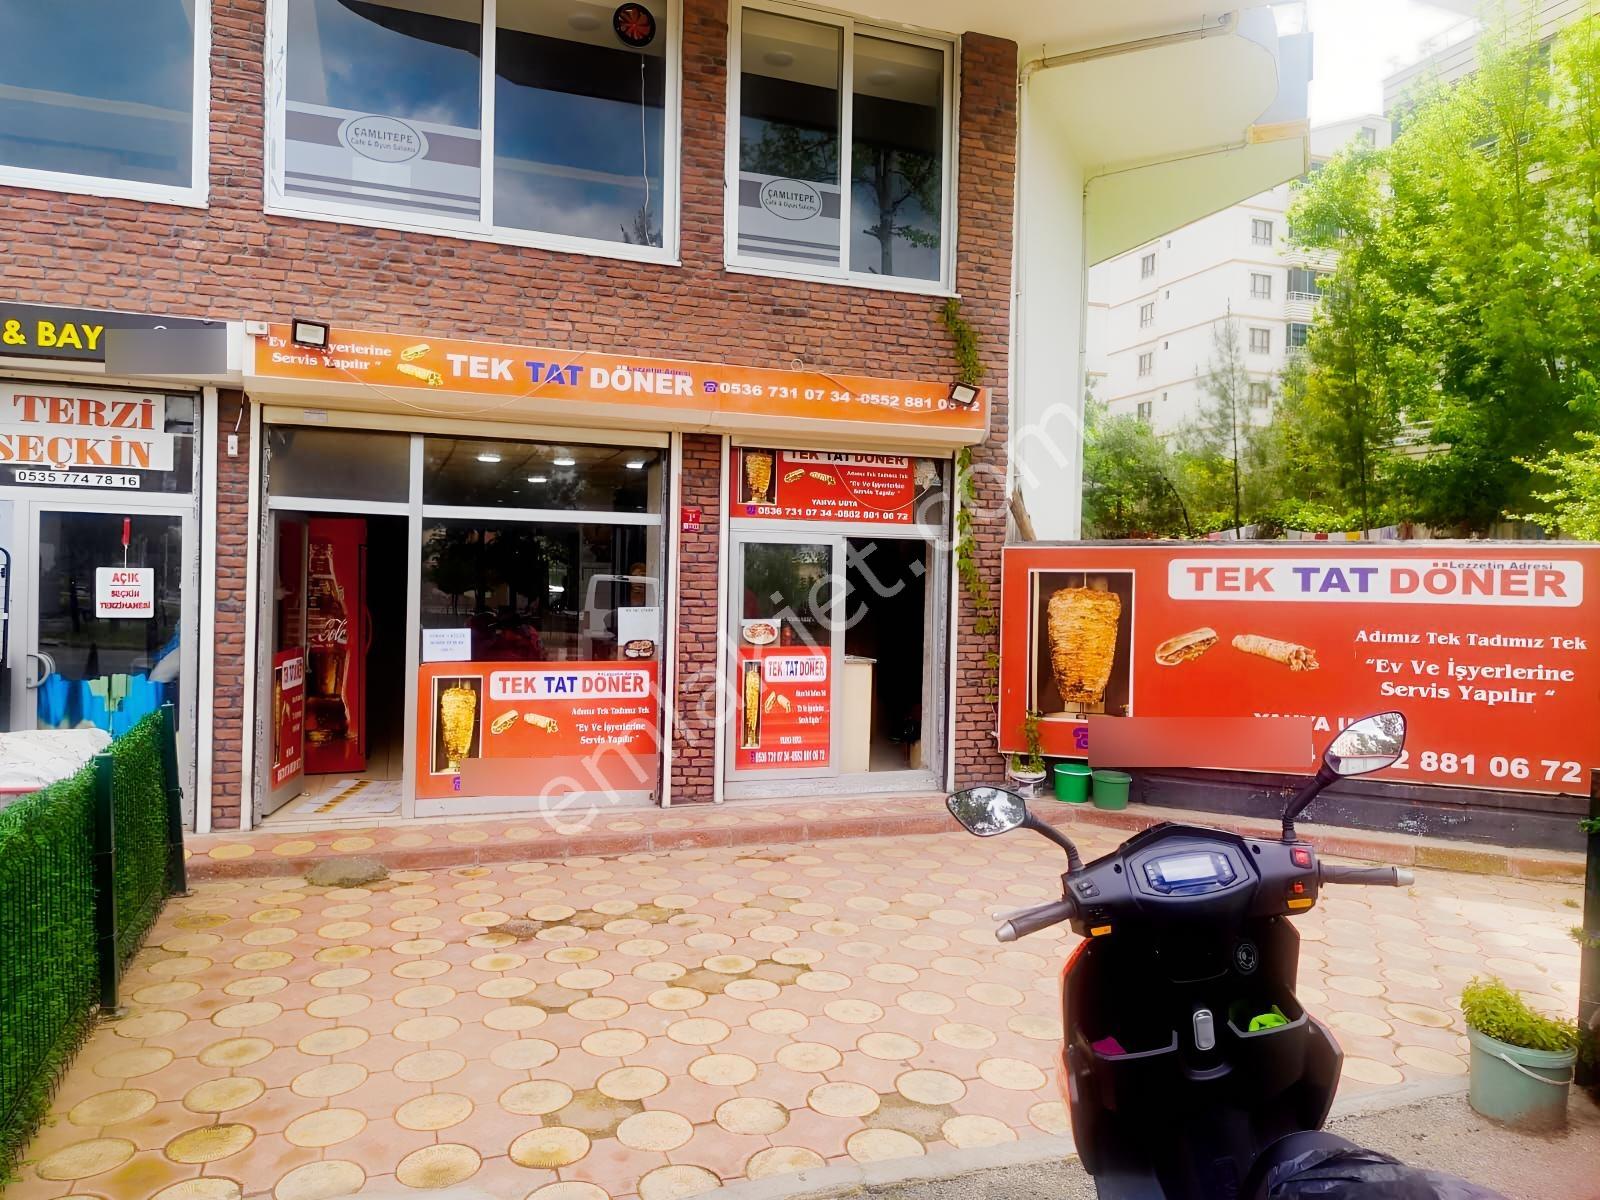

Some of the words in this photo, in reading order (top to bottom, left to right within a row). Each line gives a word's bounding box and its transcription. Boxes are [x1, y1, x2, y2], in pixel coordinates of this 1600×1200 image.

[767, 189, 815, 204] ÇAMLITEPE
[2, 319, 27, 345] &
[37, 320, 104, 350] BAY
[271, 352, 318, 366] Servis
[446, 353, 515, 382] TEK
[525, 360, 584, 386] TAT
[589, 364, 695, 397] DÖNER
[719, 382, 763, 397] 0536
[768, 386, 798, 399] 731
[804, 388, 825, 401] 07
[830, 390, 849, 403] 34
[904, 395, 932, 409] 881
[13, 393, 156, 431] TERZİ
[0, 433, 154, 469] SEÇKİN
[18, 471, 57, 483] 0535
[62, 473, 89, 484] 774
[95, 474, 113, 485] 78
[119, 476, 137, 486] 16
[785, 507, 803, 516] 731
[805, 508, 817, 517] 07
[1449, 560, 1505, 571] Lezzetin
[1509, 561, 1553, 571] Adresi
[112, 572, 139, 585] AÇIK
[1186, 566, 1275, 593] TEK
[1292, 566, 1379, 593] TAT
[1389, 562, 1567, 598] DÖNER
[1355, 630, 1421, 645] Adımız
[1425, 632, 1461, 646] Tek
[1466, 633, 1545, 650] Tadımız
[1550, 636, 1588, 651] Tek
[785, 660, 799, 676] TAT
[1411, 660, 1440, 676] Ve
[1447, 658, 1575, 682] İşyerlerine
[498, 676, 536, 694] TEK
[544, 676, 578, 693] TAT
[1380, 681, 1451, 699] Servis
[1458, 685, 1537, 706] Yapılır
[591, 722, 602, 732] Ve
[1420, 750, 1475, 775] 881
[1489, 756, 1530, 779] 06
[1540, 759, 1583, 783] 72
